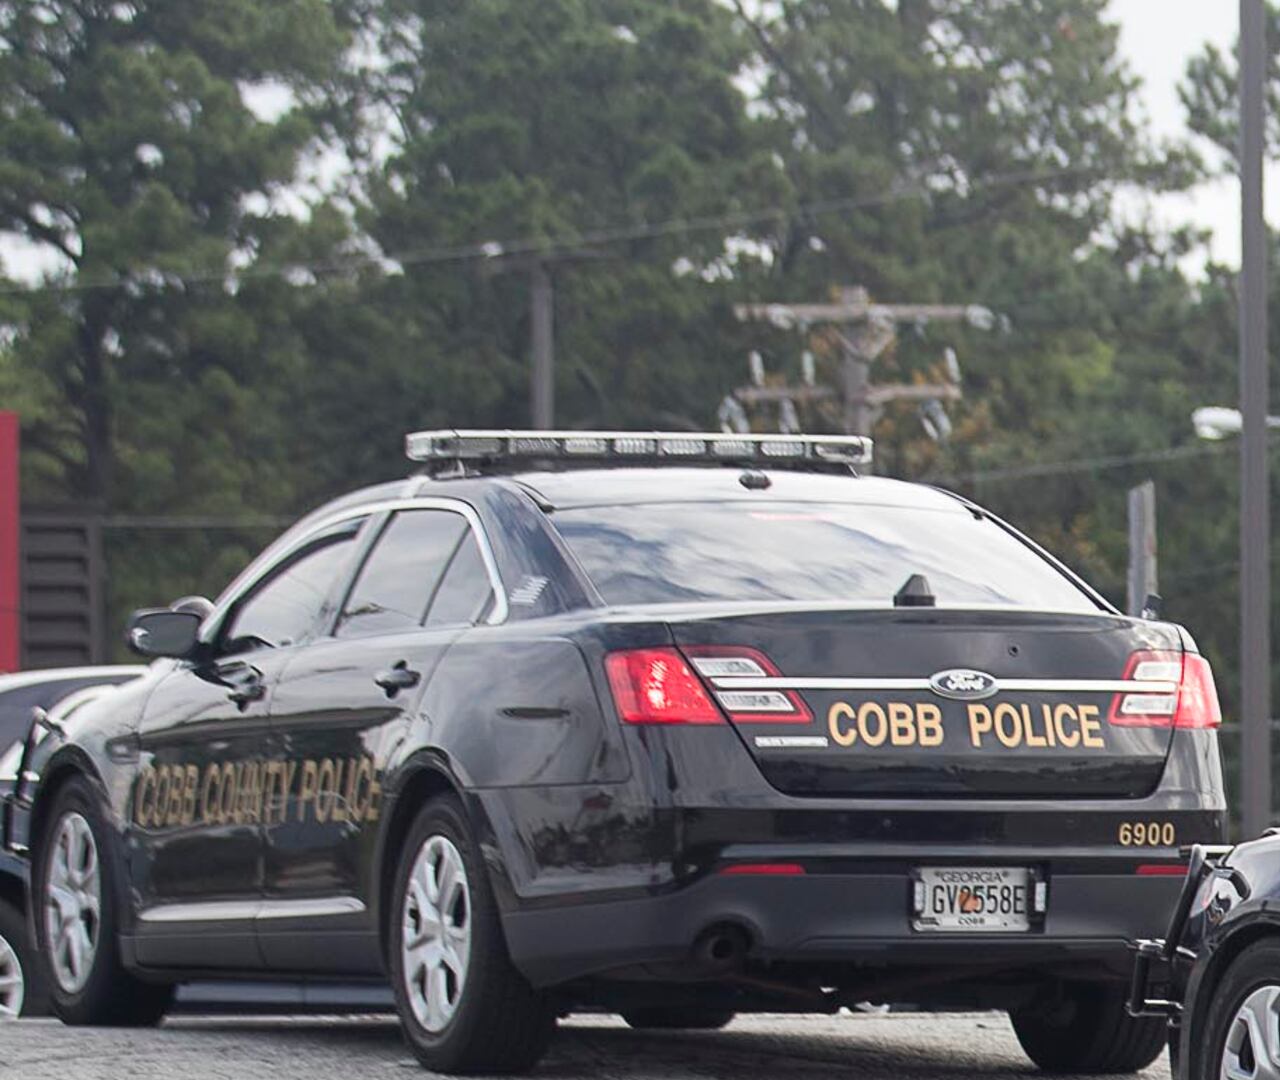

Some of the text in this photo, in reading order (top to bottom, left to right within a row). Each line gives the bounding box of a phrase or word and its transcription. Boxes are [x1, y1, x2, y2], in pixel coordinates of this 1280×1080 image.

[828, 701, 1105, 748] COBB POLICE
[136, 754, 382, 827] COBB COUNTY POLICE
[1118, 822, 1175, 846] 6900
[941, 871, 1003, 882] GEORGIA
[932, 885, 1025, 914] GV2558E
